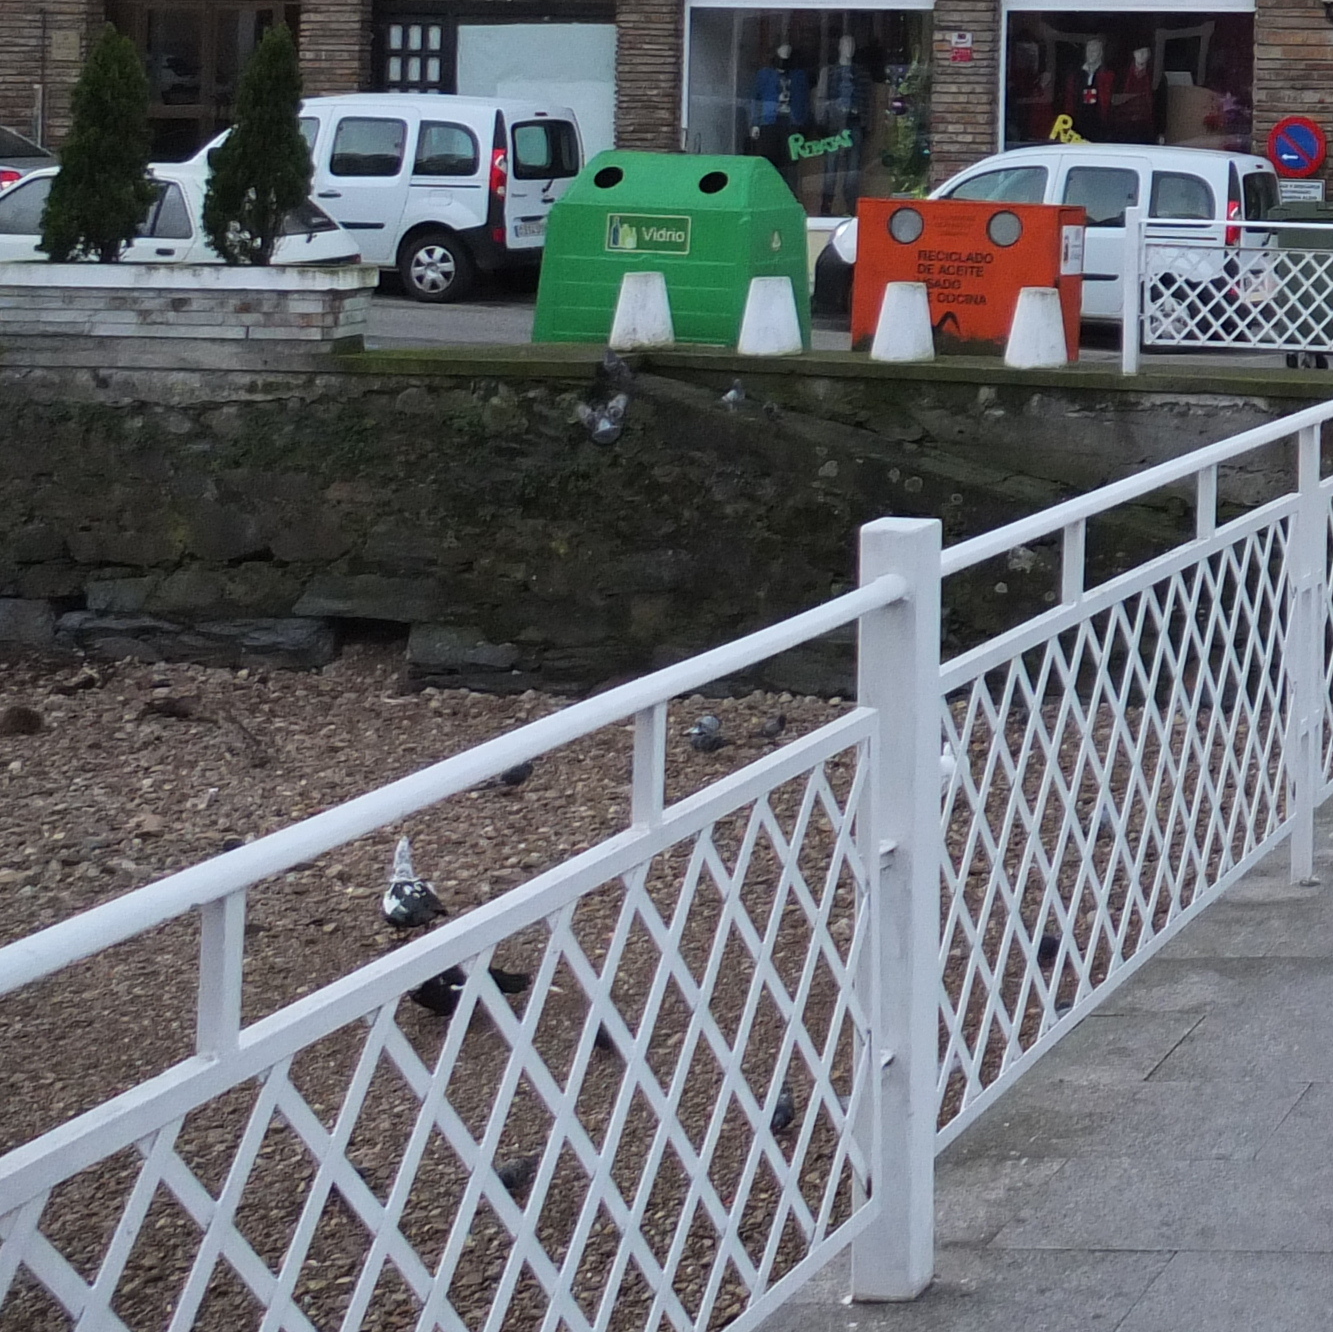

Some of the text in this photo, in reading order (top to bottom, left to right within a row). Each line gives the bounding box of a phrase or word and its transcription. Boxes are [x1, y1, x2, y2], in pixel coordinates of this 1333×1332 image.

[641, 226, 687, 243] Vidrio
[917, 250, 994, 264] RECICLADO
[917, 263, 985, 278] DE ACEITE
[936, 292, 987, 306] COCINA
